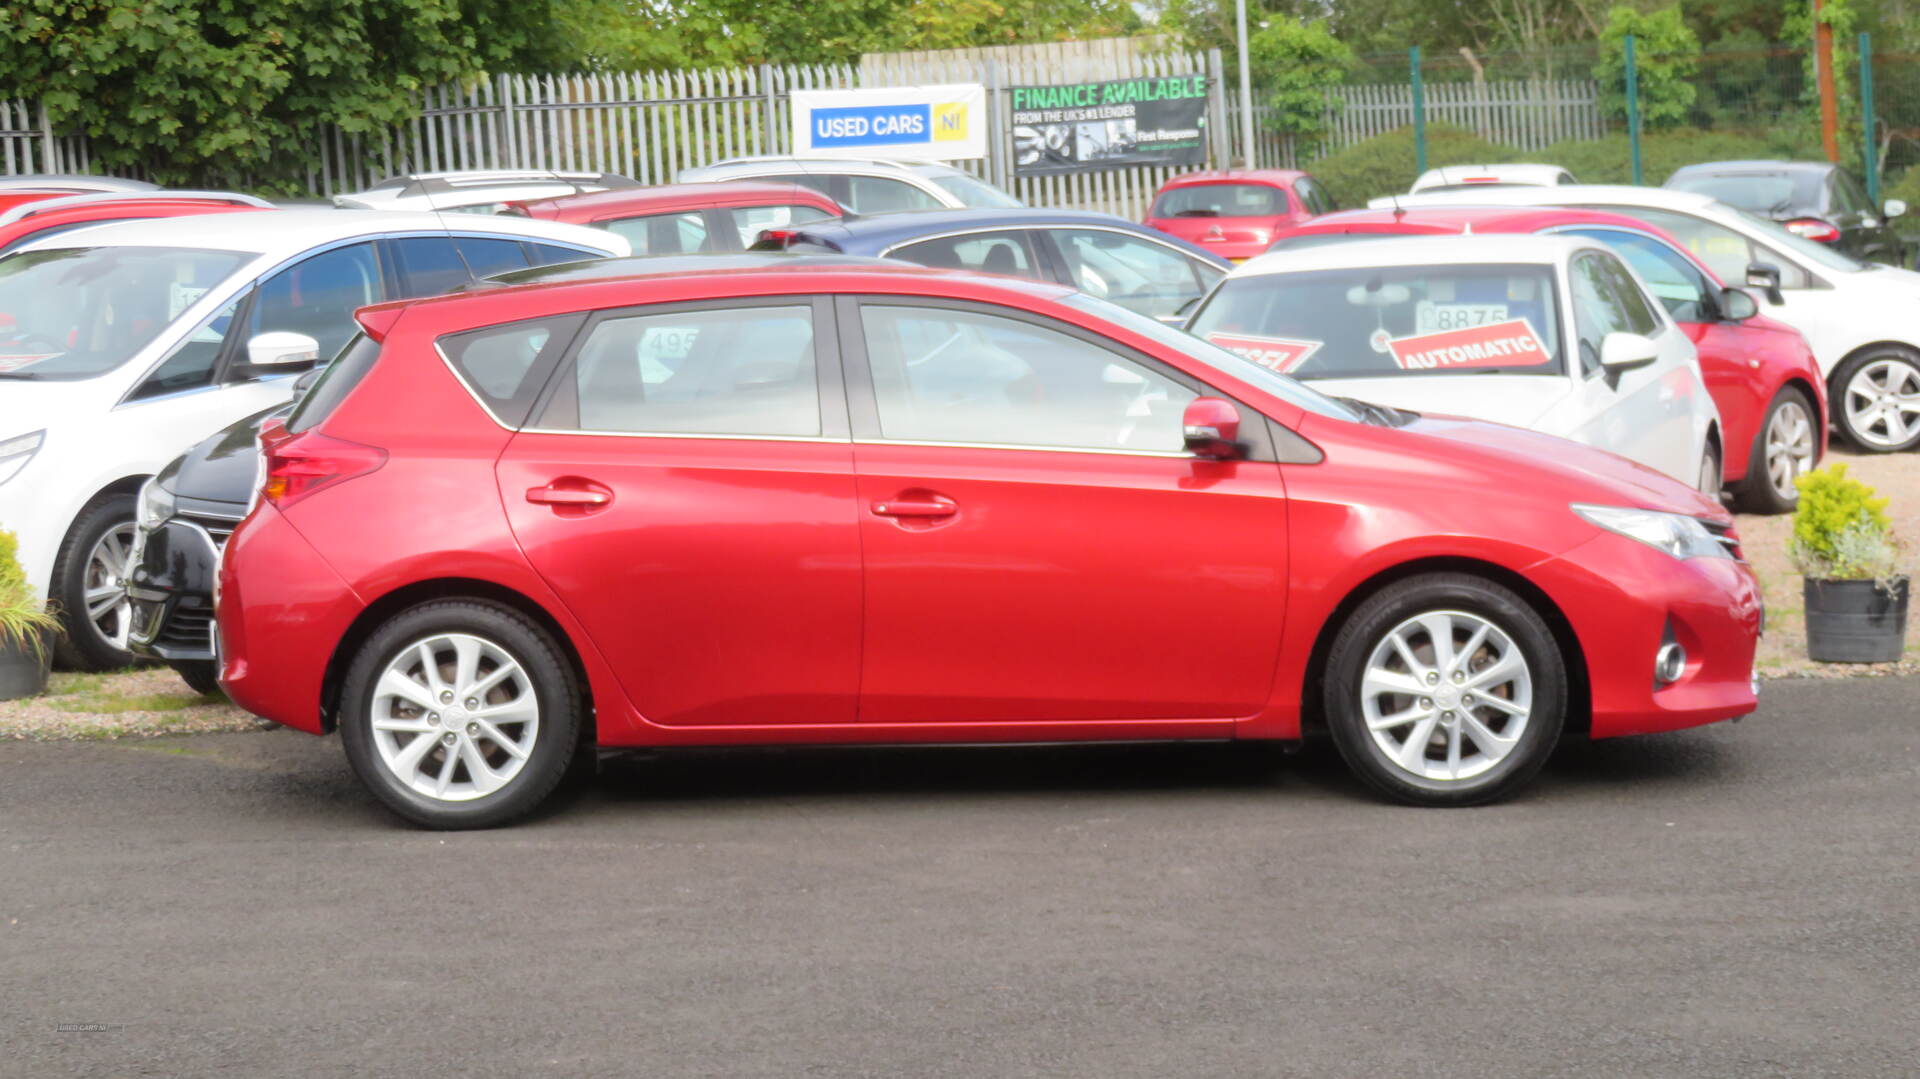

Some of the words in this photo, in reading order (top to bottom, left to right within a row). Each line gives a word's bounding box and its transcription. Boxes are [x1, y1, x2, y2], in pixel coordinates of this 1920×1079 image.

[1014, 84, 1098, 110] FINANCE
[1101, 76, 1206, 105] AVAILABLE
[817, 116, 869, 138] USED
[873, 114, 924, 136] CARS
[942, 112, 961, 131] NI
[1014, 112, 1042, 124] FROM
[1043, 110, 1063, 122] THE
[1099, 103, 1136, 118] LENDER
[1404, 335, 1537, 369] AUTOMATIC
